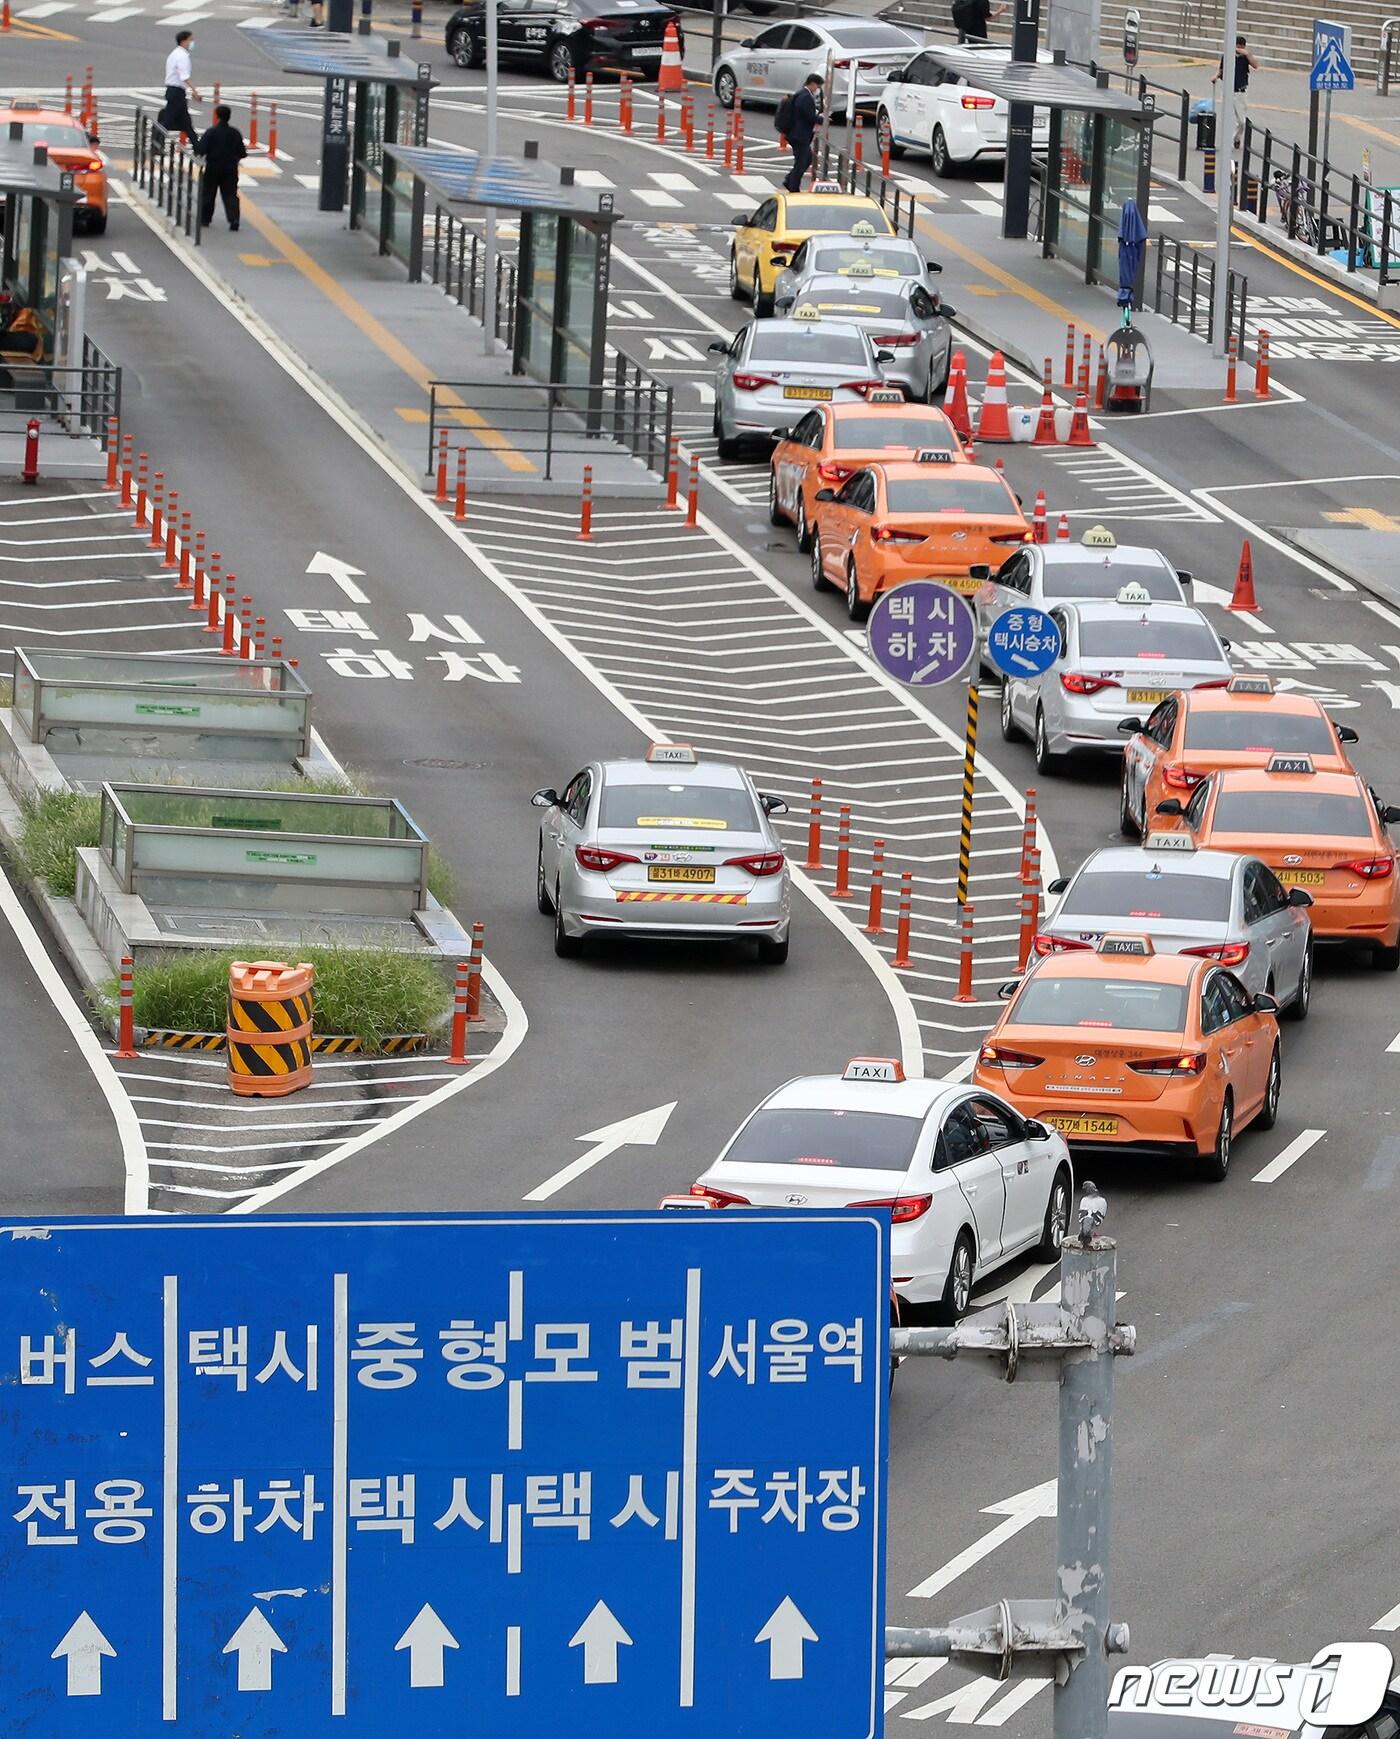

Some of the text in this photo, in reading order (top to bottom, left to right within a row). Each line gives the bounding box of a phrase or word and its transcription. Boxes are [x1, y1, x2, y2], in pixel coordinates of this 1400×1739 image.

[875, 394, 900, 402] TAXI
[923, 453, 948, 462] TAXI
[1091, 536, 1112, 544] TAXI
[1125, 593, 1146, 601] TAXI
[888, 595, 956, 625] 택시
[283, 608, 485, 643] 택시
[1007, 613, 1043, 633] 중형
[887, 631, 957, 661] 하차
[994, 632, 1057, 653] 택시승차
[319, 647, 521, 683] 하차
[664, 751, 683, 759] TAXI
[1277, 761, 1306, 770] TAXI
[1155, 838, 1186, 848] TAXI
[682, 869, 711, 880] 4907
[1294, 872, 1320, 884] 1503
[1114, 942, 1134, 952] TAXI
[852, 1066, 887, 1078] TAXI
[1083, 1120, 1114, 1133] 1544
[19, 1328, 155, 1395] 버스
[188, 1324, 318, 1392] 택시
[351, 1320, 507, 1391] 중형
[524, 1318, 684, 1390] 모범
[708, 1317, 864, 1385] 서울역
[186, 1474, 325, 1542] 하차
[349, 1473, 504, 1544] 택시
[525, 1471, 680, 1541] 택시
[708, 1465, 866, 1534] 주차장
[12, 1479, 153, 1546] 전용
